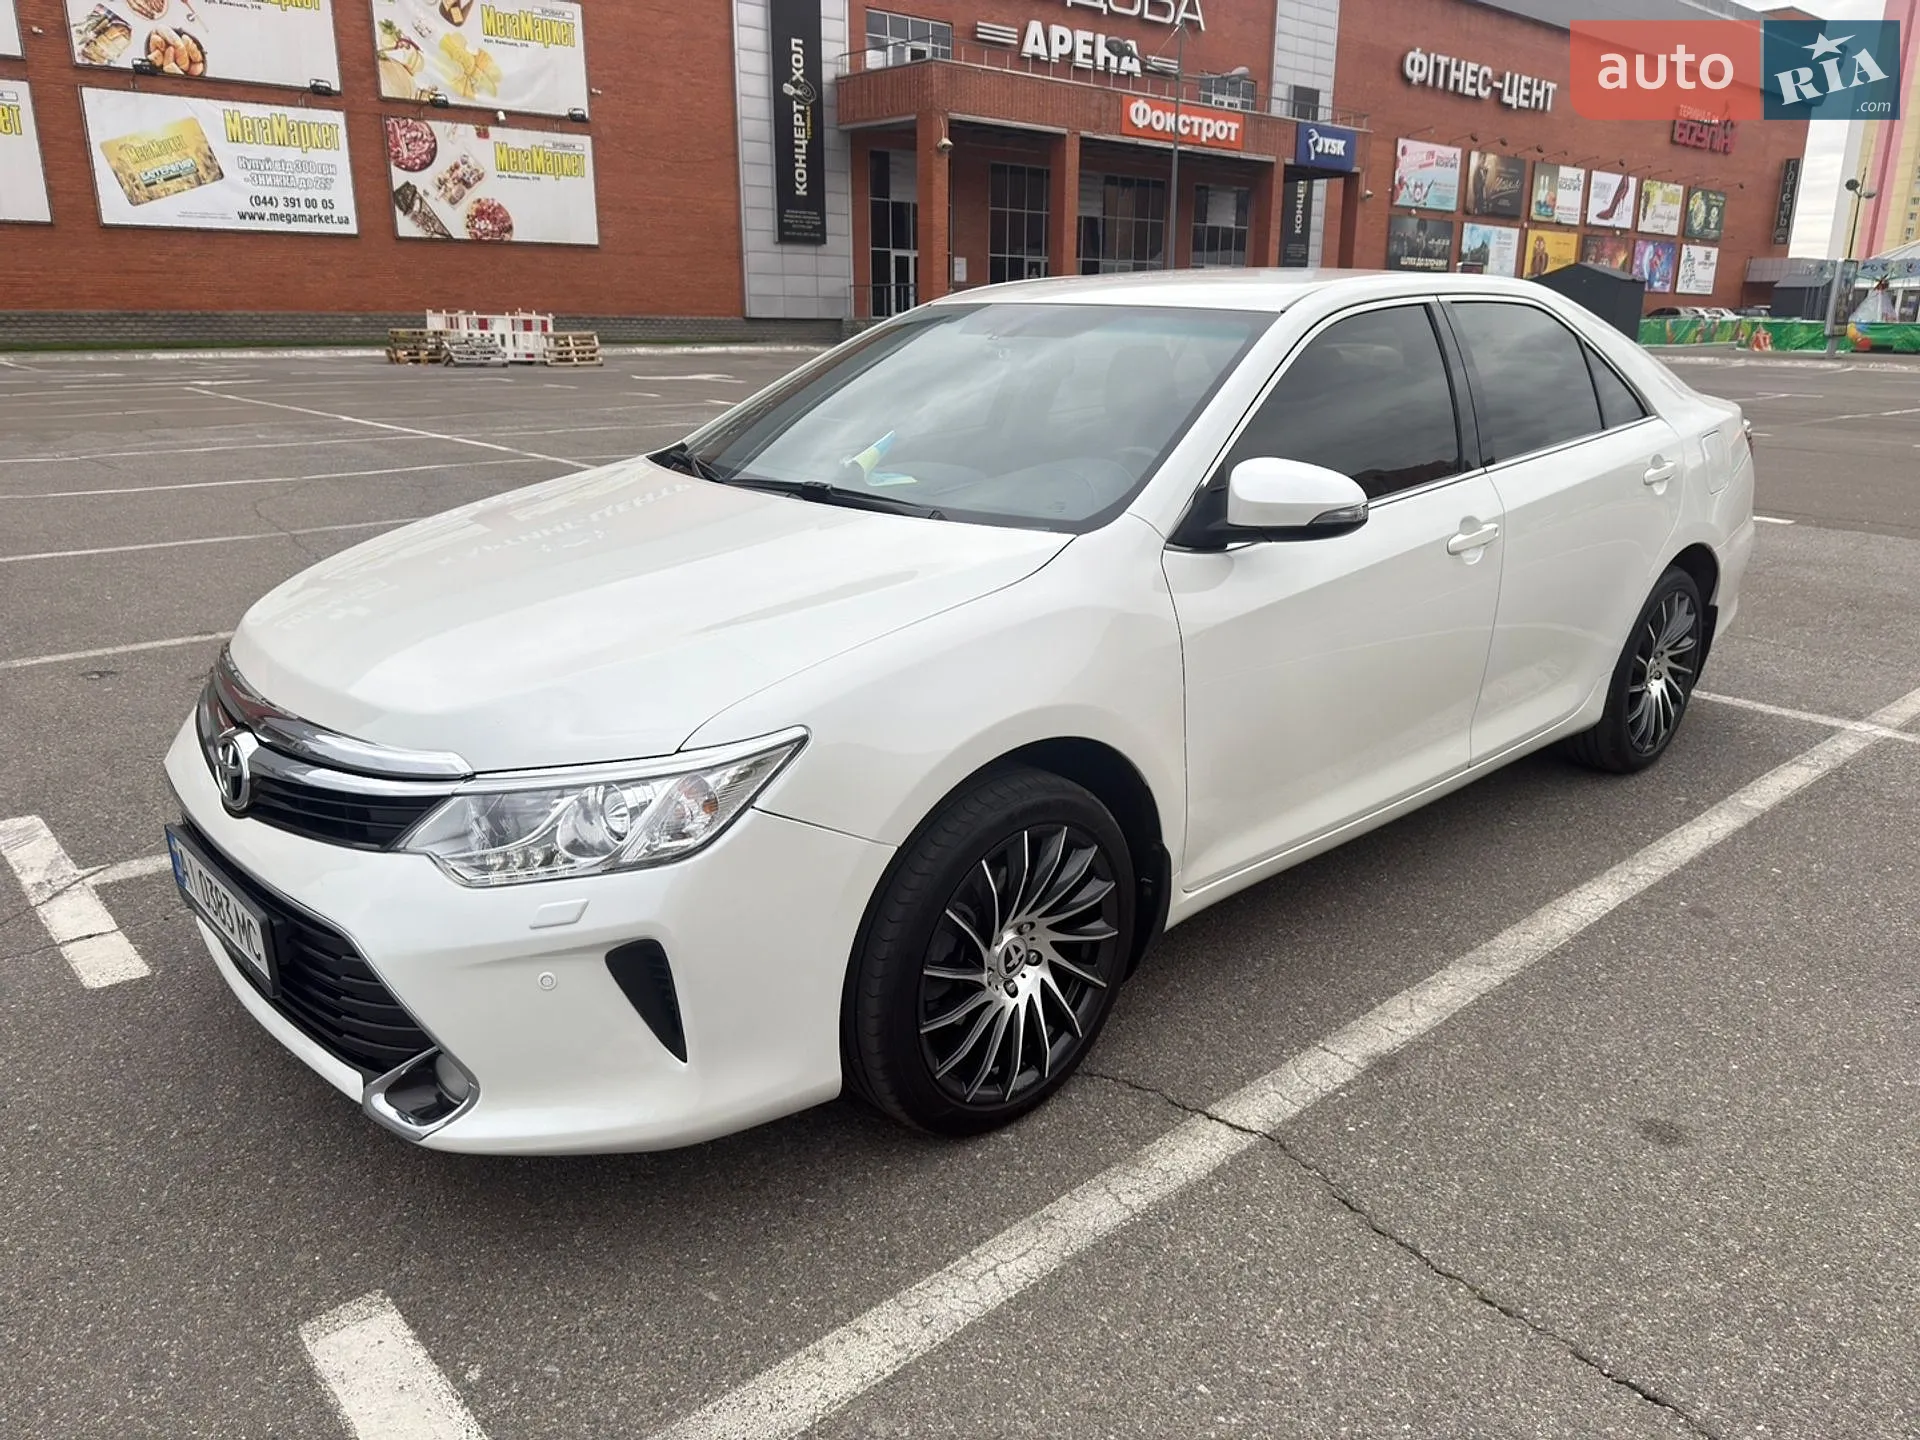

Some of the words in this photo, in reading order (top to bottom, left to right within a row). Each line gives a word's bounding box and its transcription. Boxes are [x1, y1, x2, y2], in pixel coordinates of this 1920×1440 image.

[481, 4, 575, 48] МегаМаркет
[790, 37, 805, 83] ХОЛ
[1020, 20, 1142, 77] АРЕНА
[1405, 47, 1558, 112] ФІТНЕС-ЦЕНТ
[223, 109, 340, 153] МегаМаркет
[1129, 98, 1240, 143] Фокстрот
[494, 141, 585, 180] МегаМаркет
[792, 100, 809, 196] КОНЦЕРТ
[1316, 135, 1347, 157] JYSK
[237, 210, 350, 225] www.megamarket.ua
[249, 195, 279, 209] (044)
[282, 197, 301, 209] 391
[304, 198, 318, 209] 00
[321, 199, 335, 210] 05
[1294, 180, 1307, 234] КОНЦЕ
